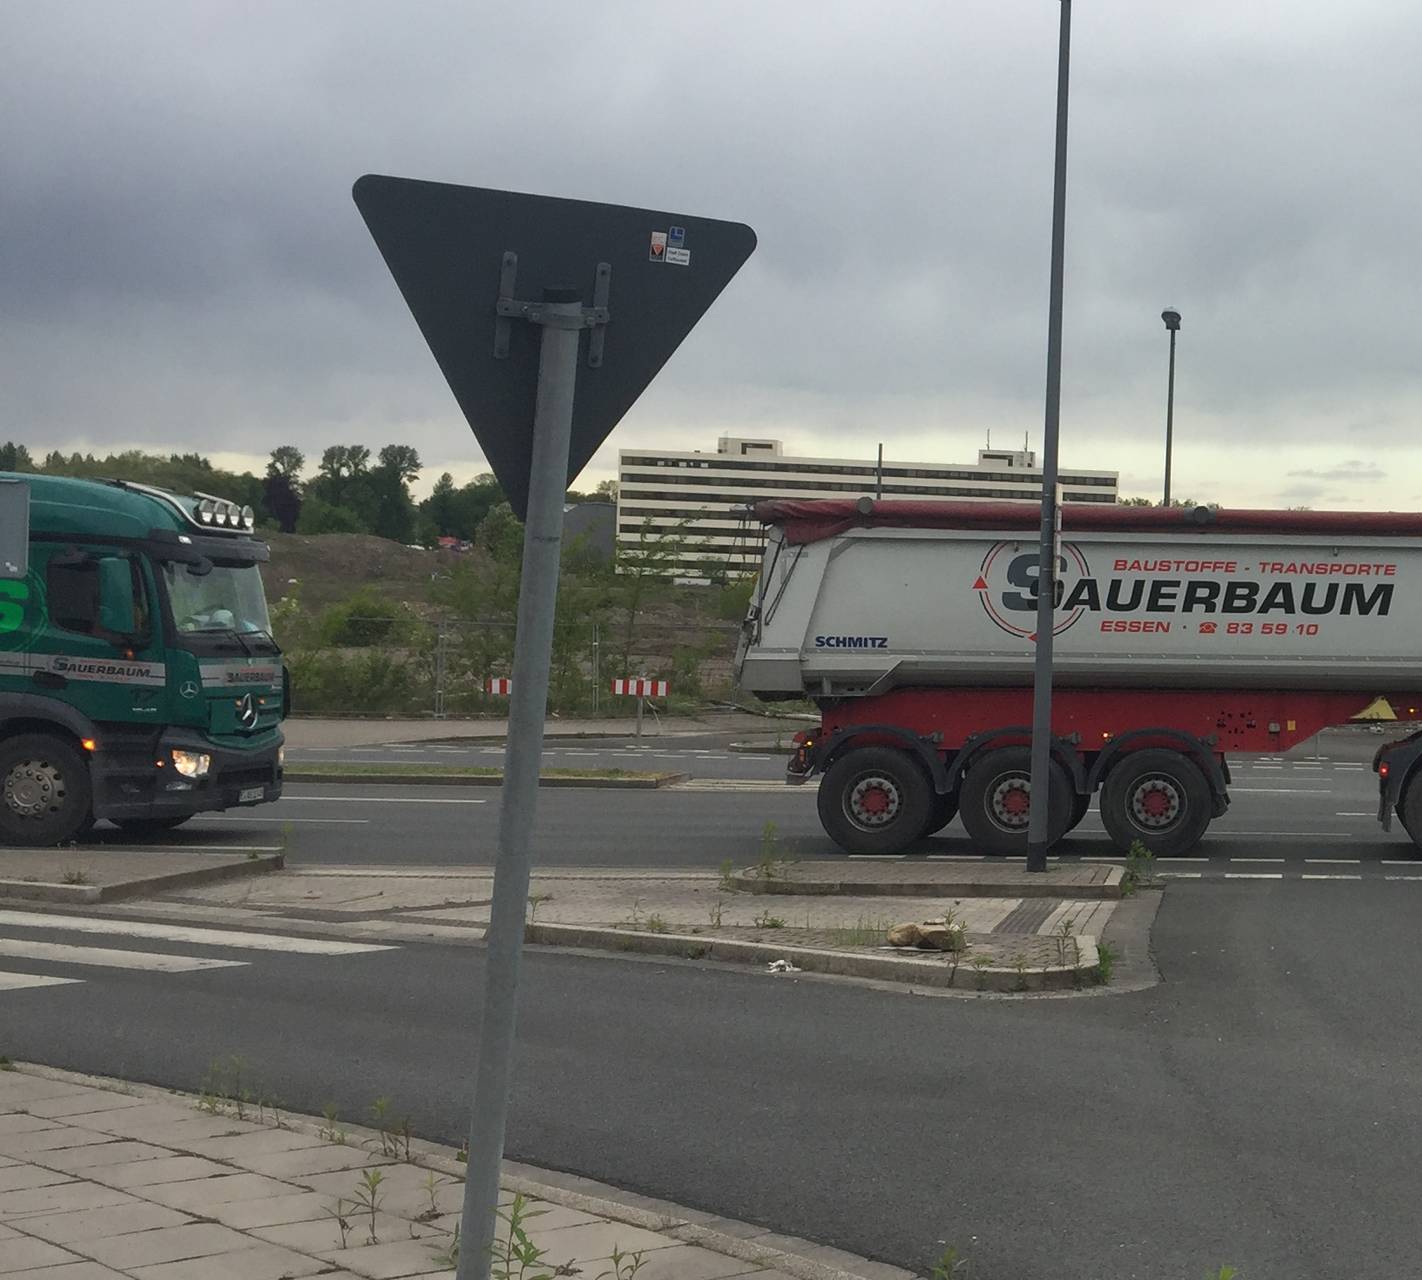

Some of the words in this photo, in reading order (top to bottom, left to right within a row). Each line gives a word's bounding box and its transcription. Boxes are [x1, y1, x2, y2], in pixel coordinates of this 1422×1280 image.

[1113, 559, 1238, 574] BAUSTOFFE
[1259, 561, 1398, 577] TRANSPORTE
[1001, 553, 1396, 616] SAUERBAUM
[1099, 620, 1171, 634] ESSEN
[1226, 622, 1254, 635] 83
[1260, 623, 1288, 636] 59
[1295, 624, 1320, 636] 10
[814, 635, 889, 649] SCHMITZ
[52, 656, 151, 679] SAUERBAUM
